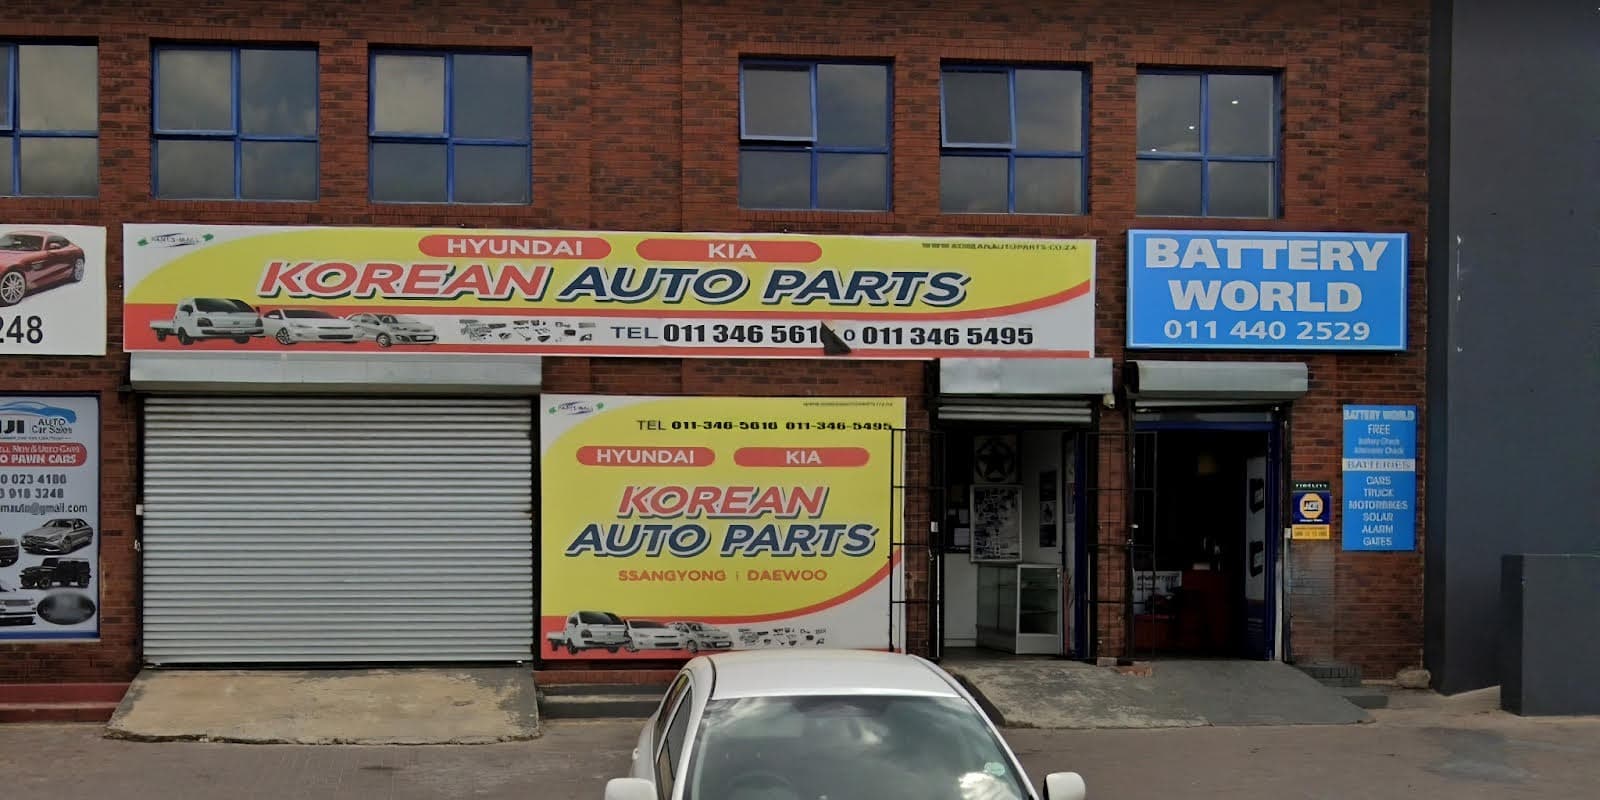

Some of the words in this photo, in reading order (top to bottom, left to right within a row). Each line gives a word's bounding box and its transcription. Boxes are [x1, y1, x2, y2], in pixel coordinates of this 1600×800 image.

[447, 238, 583, 256] HYUNDAI
[708, 243, 757, 259] KIA
[1145, 237, 1388, 272] BATTERY
[258, 261, 553, 300] KOREAN
[557, 266, 749, 304] AUTO
[761, 269, 971, 308] PARTS
[1167, 279, 1363, 313] WORLD
[610, 326, 659, 339] TEL
[663, 324, 706, 342] 011
[713, 324, 764, 343] 346
[771, 325, 825, 344] 561
[862, 326, 904, 345] 011
[910, 326, 960, 345] 346
[967, 327, 1034, 346] 5495
[1164, 319, 1217, 339] 011
[1230, 320, 1287, 339] 440
[1297, 321, 1370, 341] 2529
[0, 420, 25, 434] JI
[38, 418, 66, 426] AUTO
[637, 419, 667, 431] TEL
[32, 425, 47, 434] Car
[49, 425, 73, 434] Sales
[1367, 424, 1391, 434] FREE
[11, 454, 46, 464] PAWN
[48, 454, 77, 464] CARS
[596, 449, 695, 465] HYUNDAI
[786, 450, 822, 465] KIA
[1347, 460, 1411, 469] BATTERIES
[11, 474, 34, 484] 023
[1366, 476, 1392, 485] CARS
[9, 488, 31, 499] 918
[35, 488, 64, 499] 3248
[1364, 488, 1394, 497] TRUCK
[617, 485, 829, 519] KOREAN
[1348, 500, 1409, 510] MOTORBIKES
[1363, 512, 1394, 522] SOLAR
[1361, 524, 1394, 534] ALARM
[565, 523, 712, 558] AUTO
[719, 523, 879, 558] PARTS
[1362, 537, 1393, 546] GATES
[618, 569, 726, 582] SSANGYONG
[747, 570, 828, 582] DAEWOO
